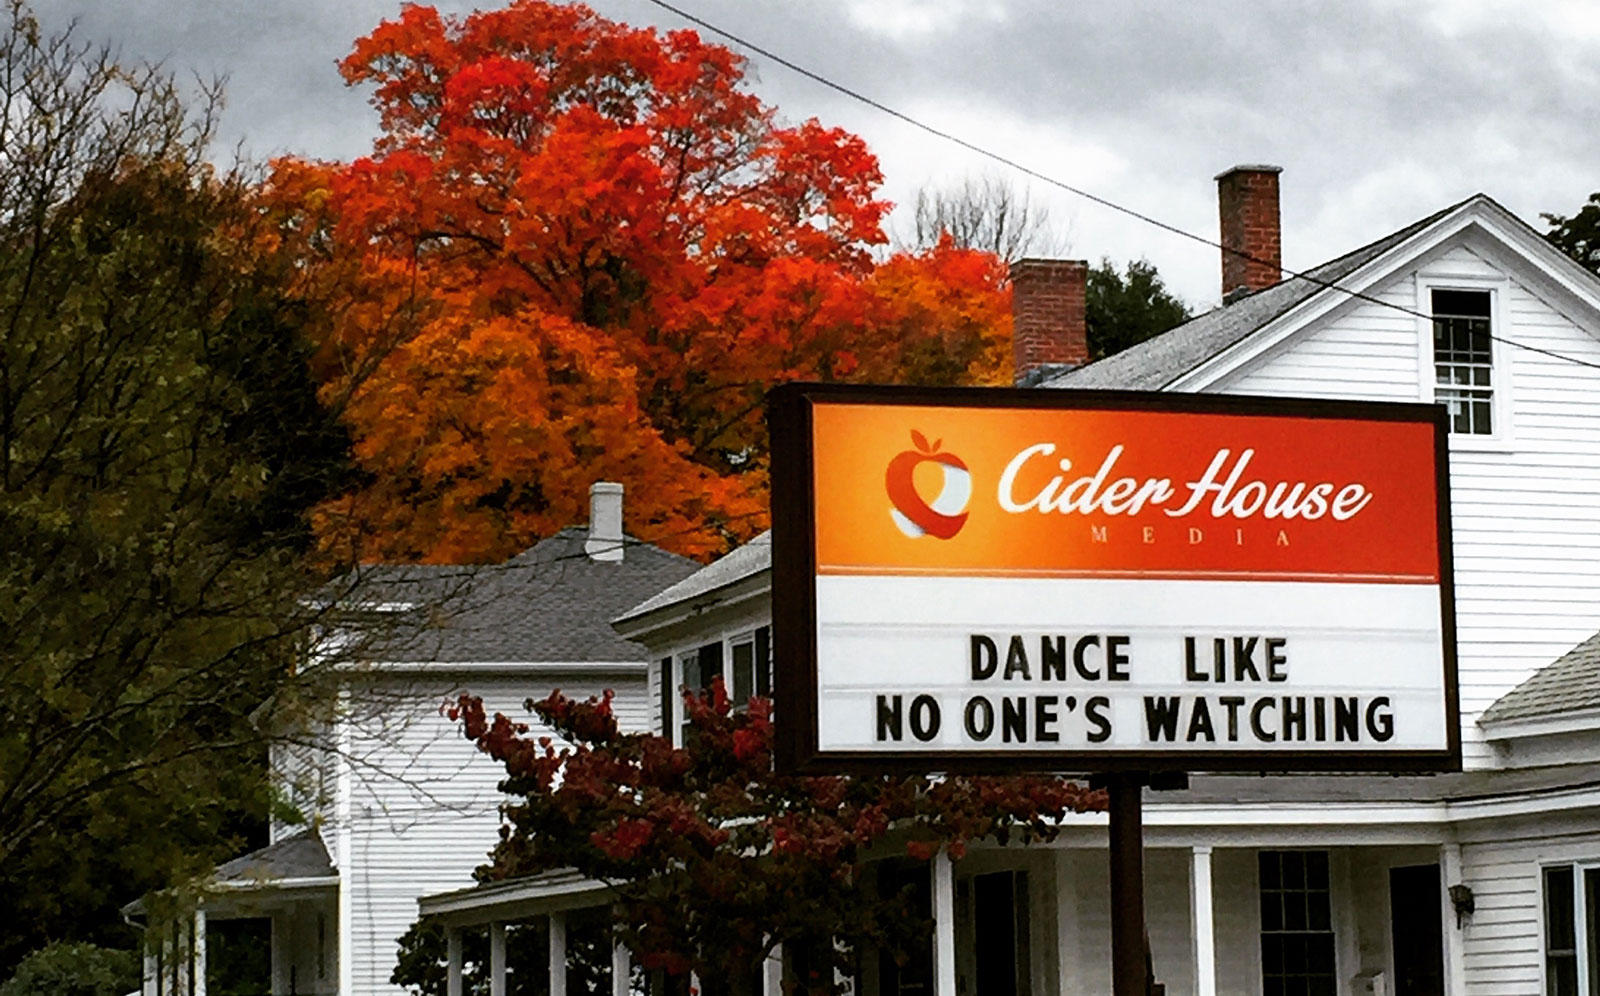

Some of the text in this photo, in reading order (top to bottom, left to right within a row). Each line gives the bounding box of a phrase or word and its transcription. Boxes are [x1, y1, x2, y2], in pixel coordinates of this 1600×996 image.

[998, 442, 1372, 521] Cider House
[1091, 525, 1291, 547] MEDIA
[970, 634, 1288, 682] DANCE LIKE
[876, 694, 1394, 743] NO ONE'S WATCHING
